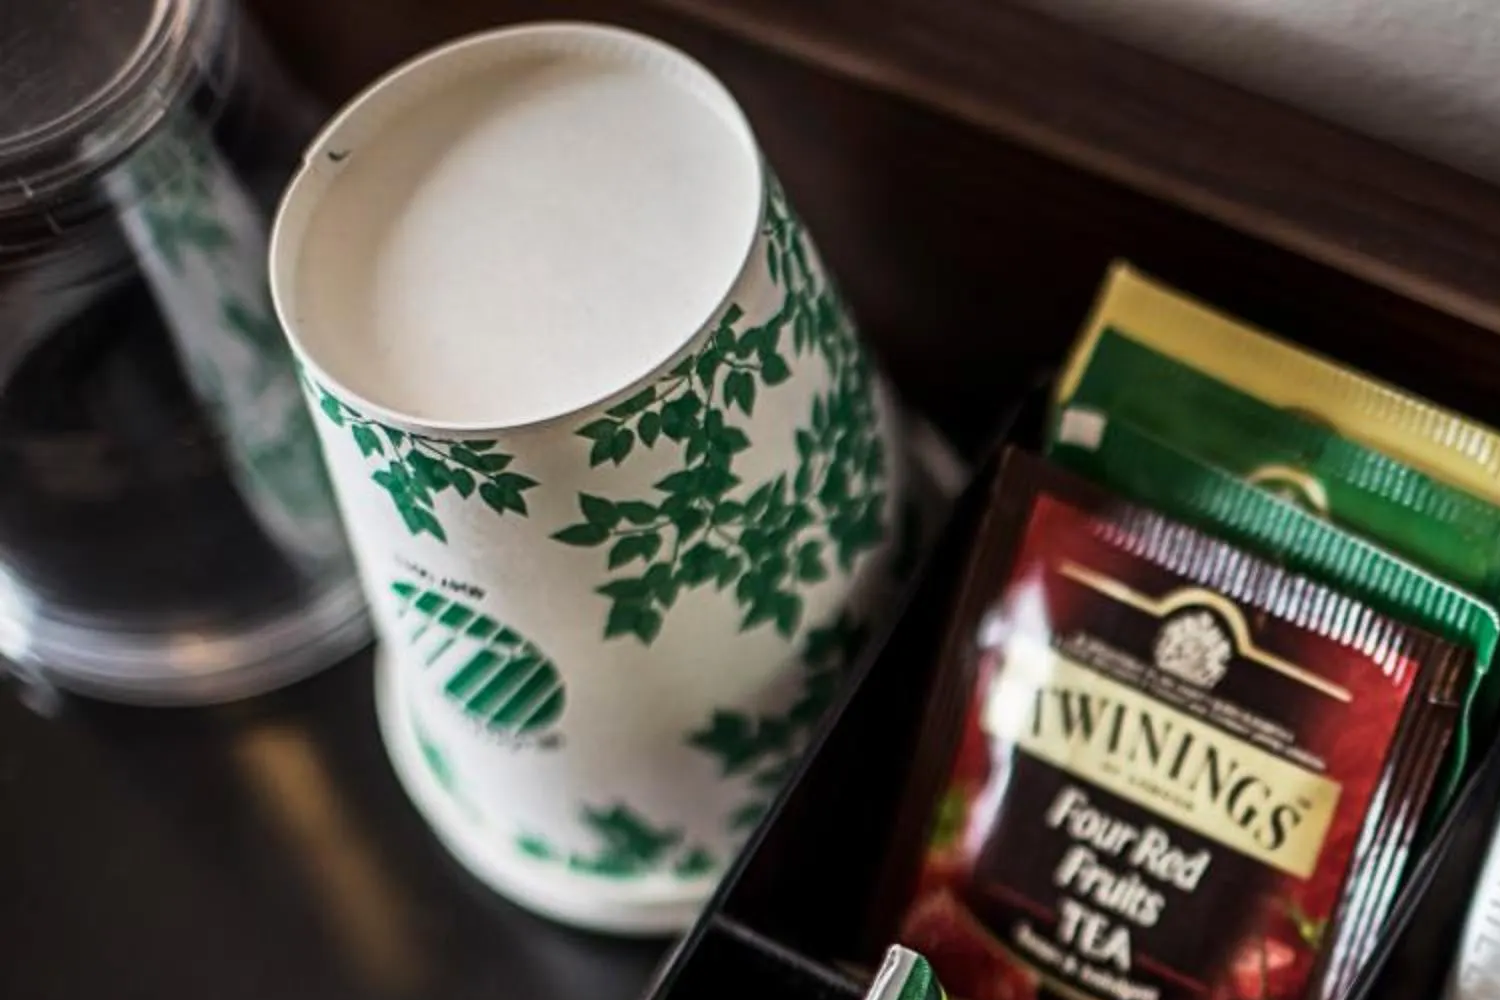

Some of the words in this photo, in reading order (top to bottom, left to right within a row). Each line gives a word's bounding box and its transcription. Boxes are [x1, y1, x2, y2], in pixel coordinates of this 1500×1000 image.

[1046, 786, 1140, 856] Four
[1132, 815, 1210, 892] Red
[1055, 846, 1166, 928] Fruits
[1055, 908, 1132, 971] TEA
